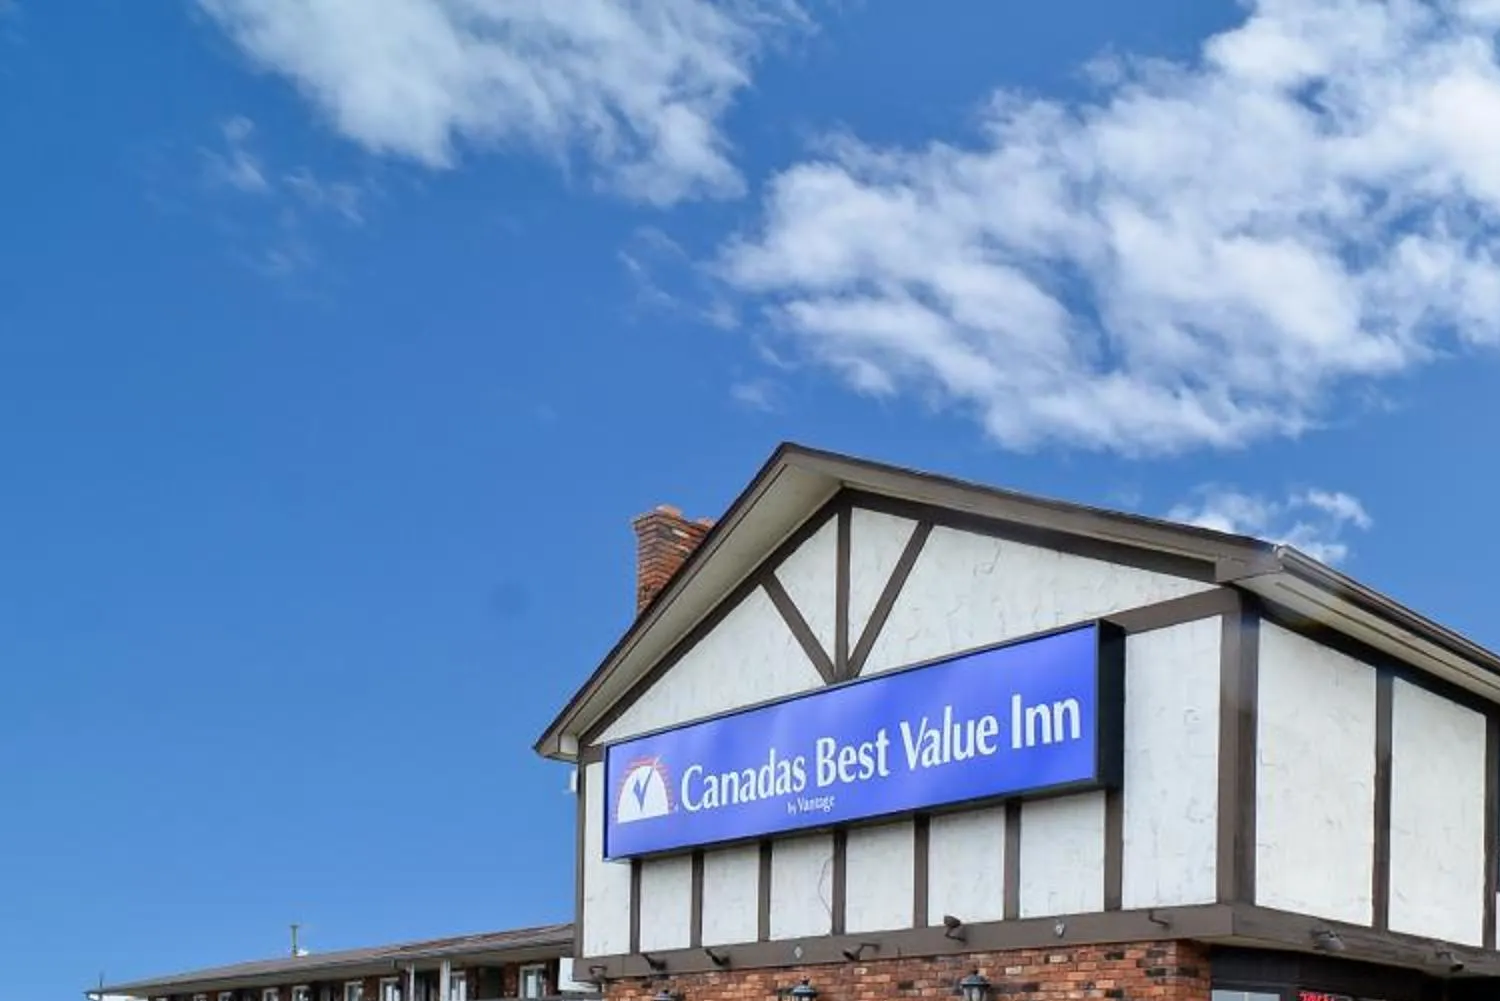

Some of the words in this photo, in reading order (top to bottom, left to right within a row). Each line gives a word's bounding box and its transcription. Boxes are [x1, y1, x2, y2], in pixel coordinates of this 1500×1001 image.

[681, 747, 807, 812] Canadas
[815, 728, 890, 788] Best
[900, 704, 999, 771] Value
[1011, 692, 1081, 749] Inn
[787, 800, 797, 816] by
